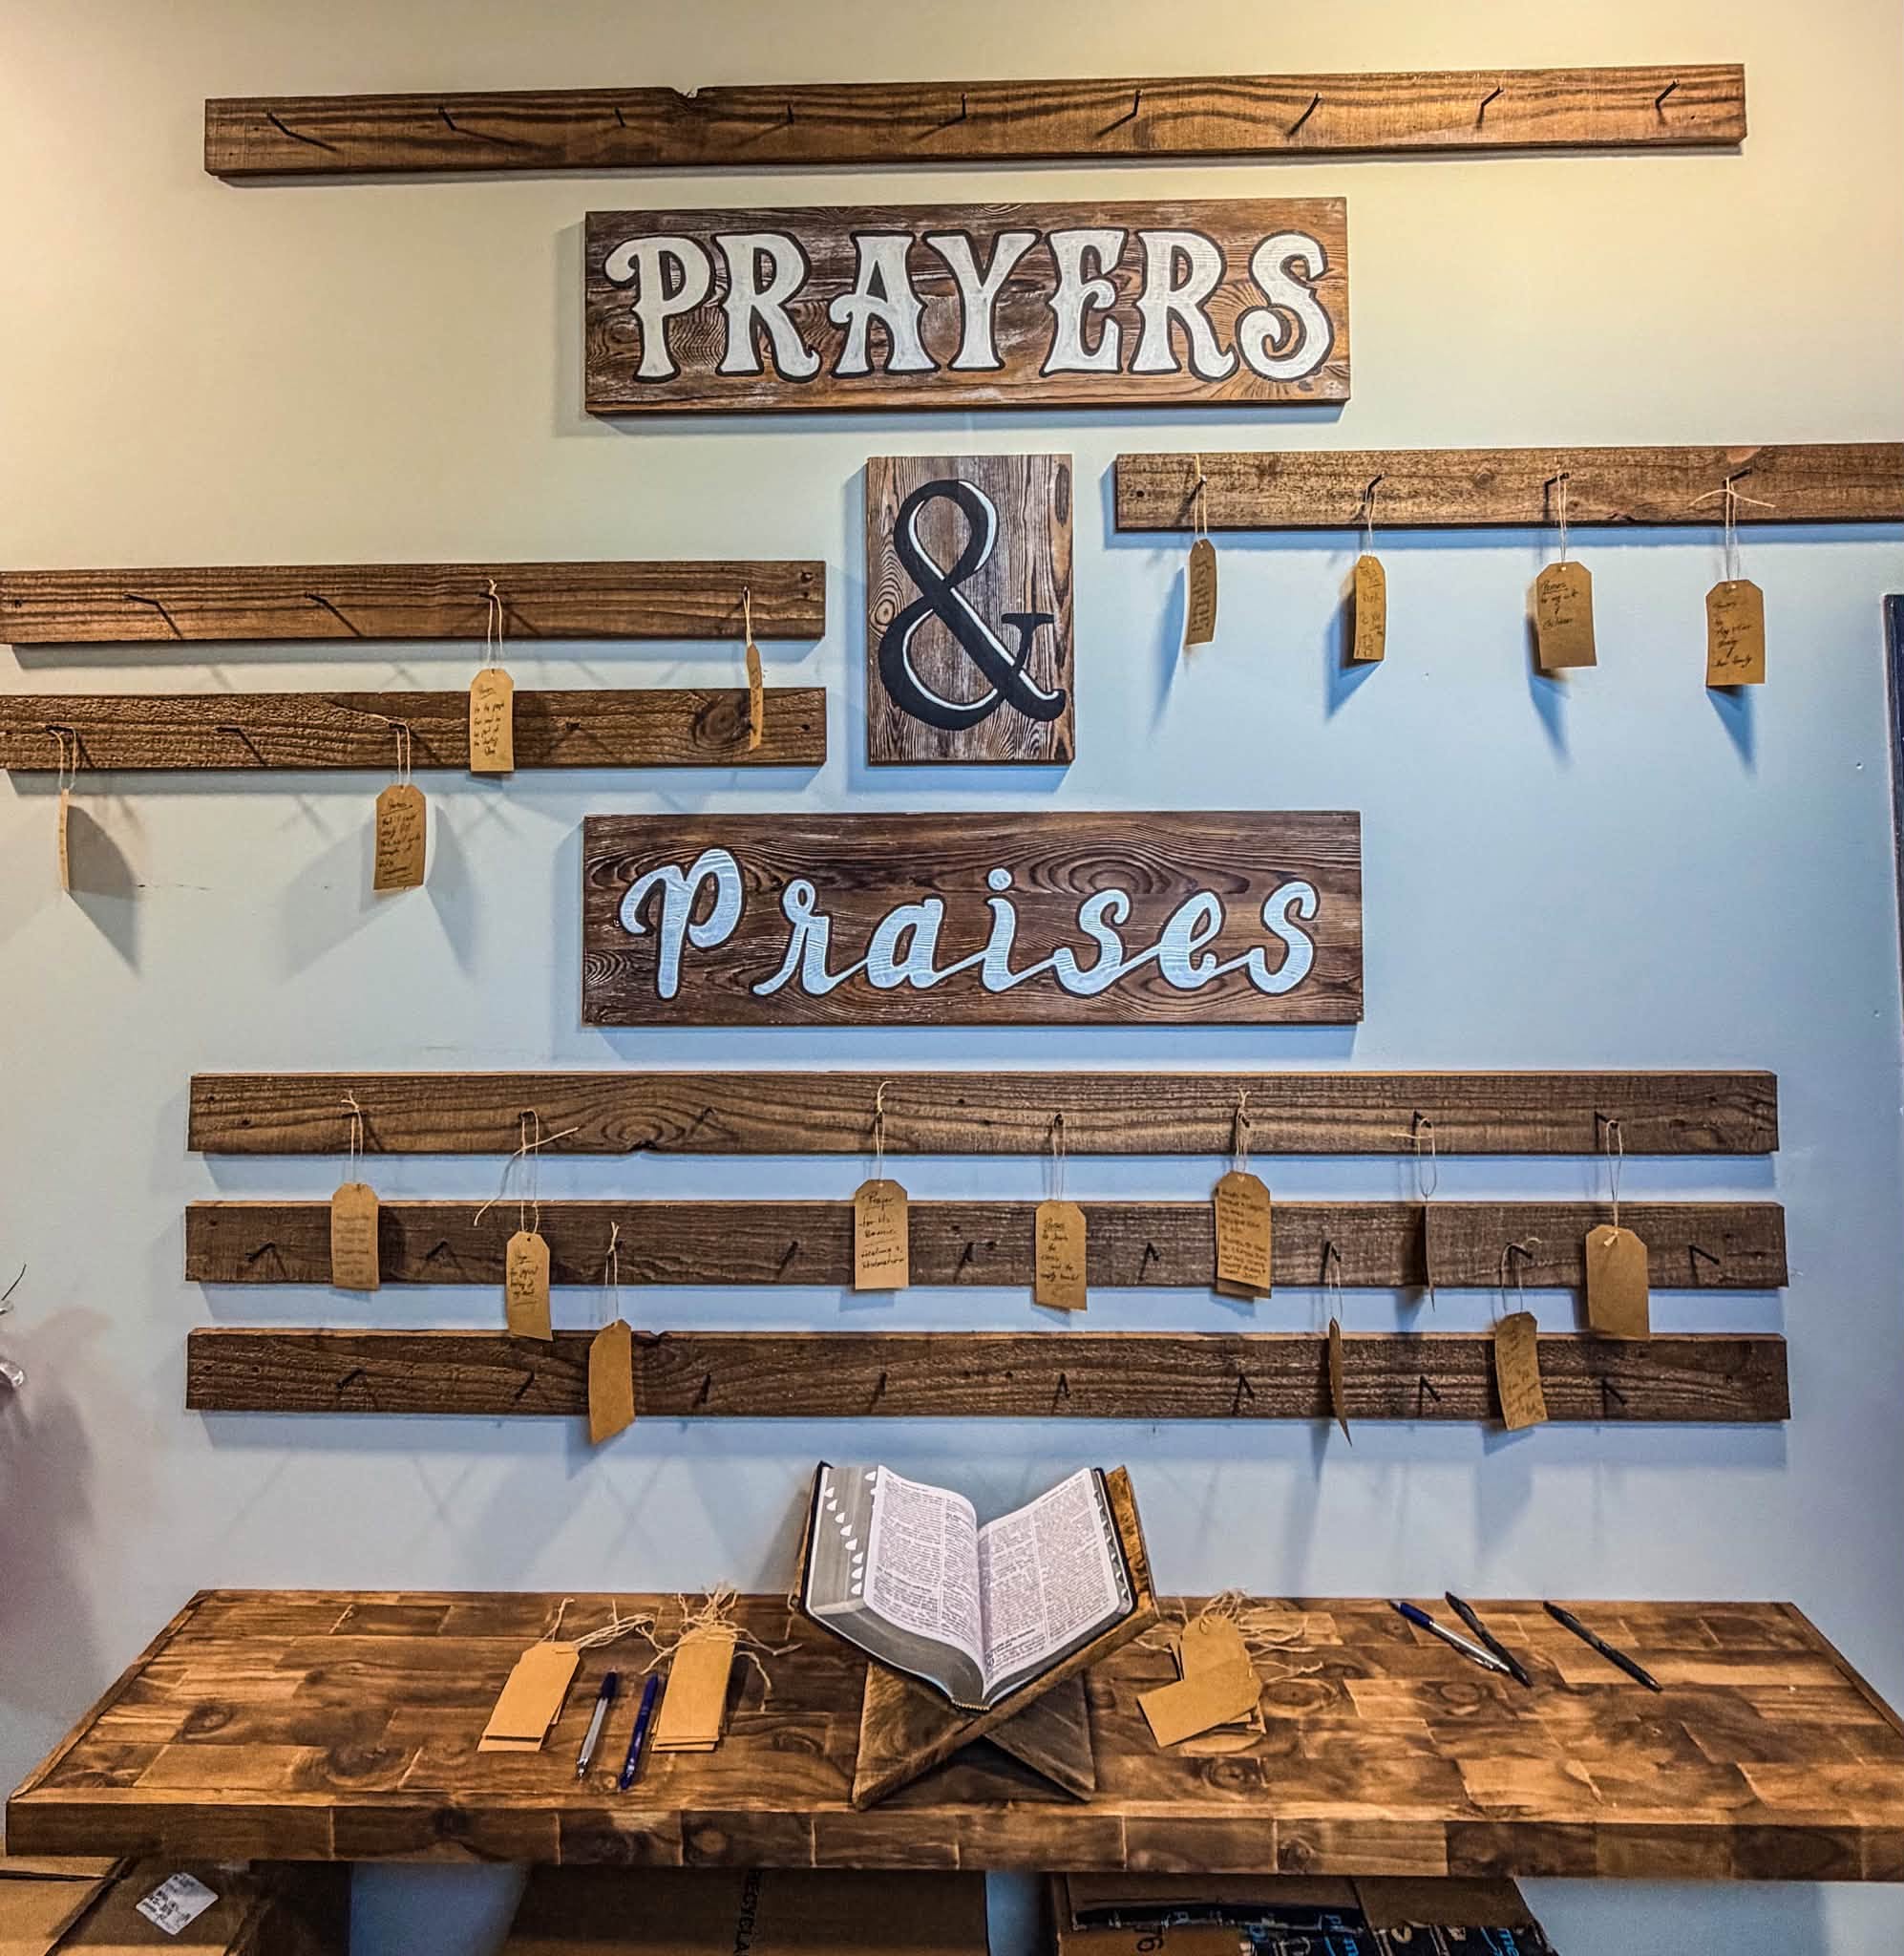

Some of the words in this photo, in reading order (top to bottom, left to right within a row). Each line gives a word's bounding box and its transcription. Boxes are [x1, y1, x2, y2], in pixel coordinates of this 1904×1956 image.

[603, 228, 1336, 381] PRAYERS
[878, 478, 1067, 732] &
[617, 845, 1322, 1000] Praises
